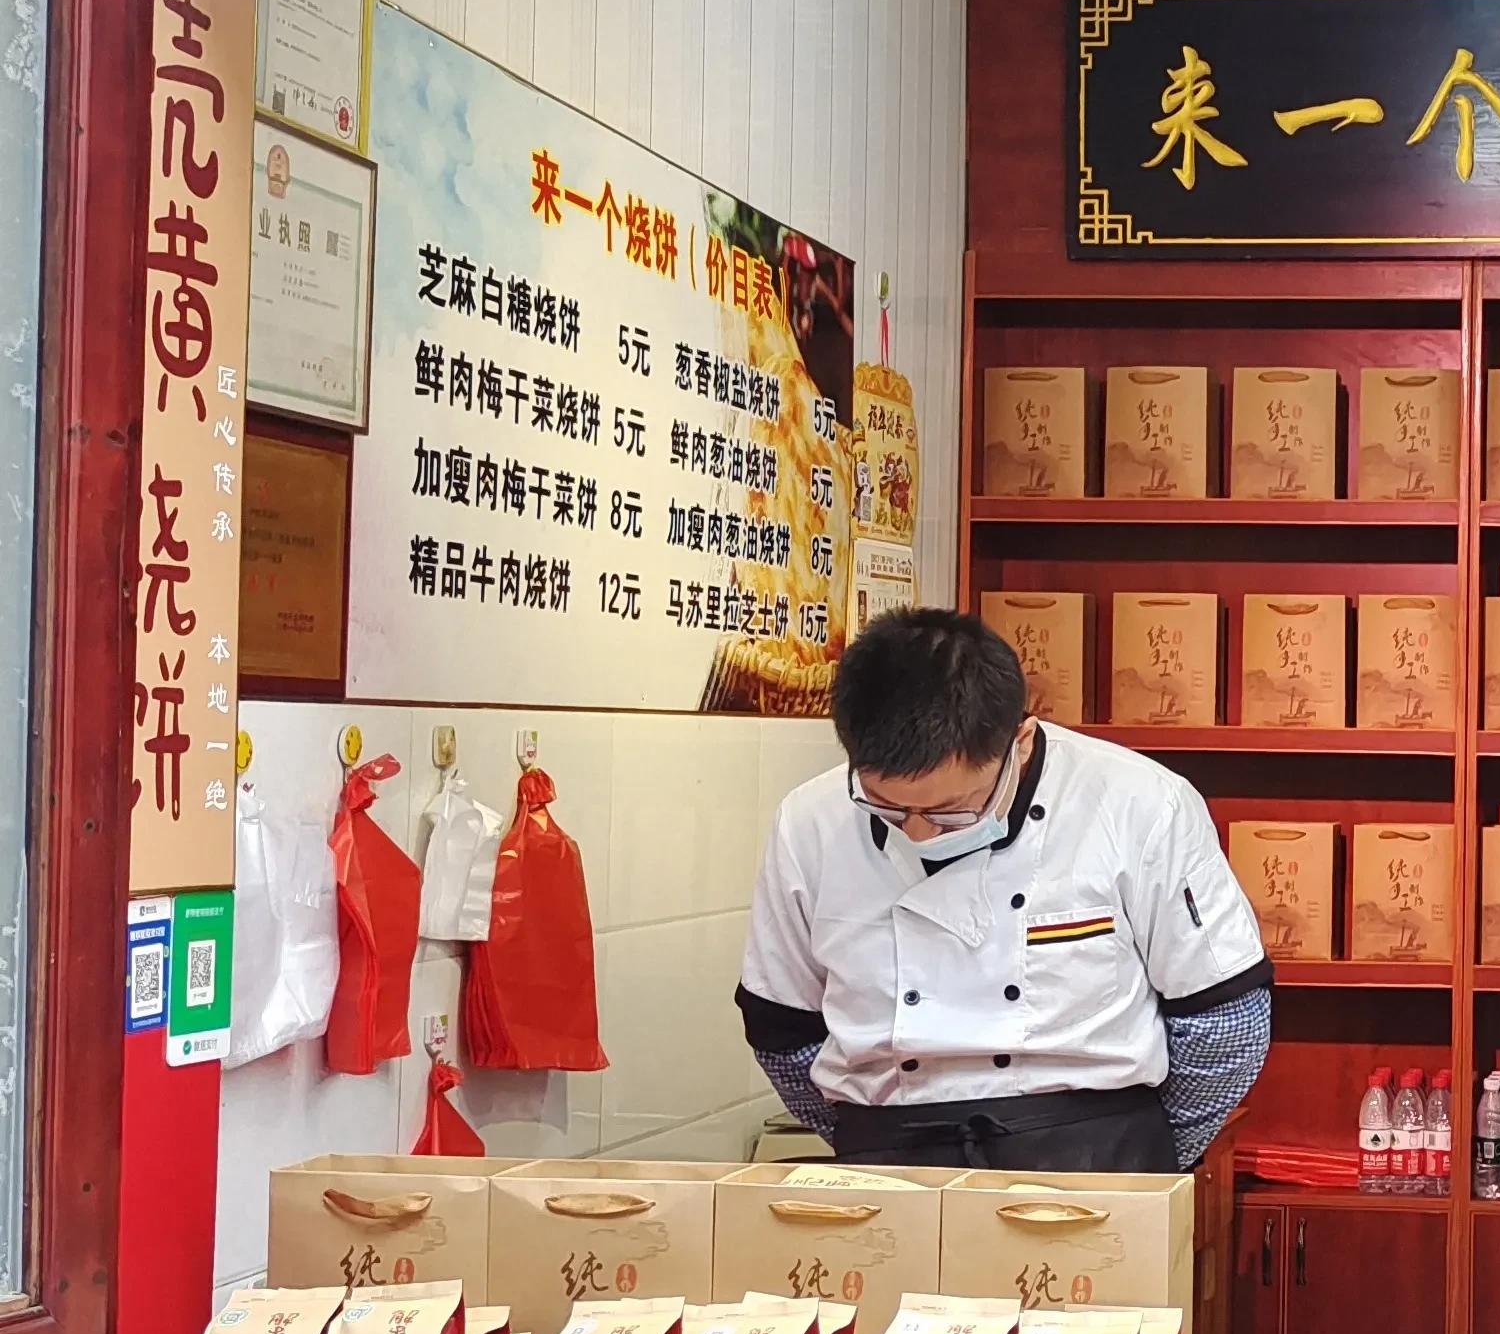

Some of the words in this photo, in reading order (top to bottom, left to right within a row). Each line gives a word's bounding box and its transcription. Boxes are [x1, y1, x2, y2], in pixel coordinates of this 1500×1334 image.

[414, 339, 601, 446] 鲜肉梅干菜烧饼
[613, 406, 646, 457] 5元
[670, 418, 777, 495] 鲜肉葱油烧饼
[811, 467, 833, 508] 5元
[417, 242, 581, 353] 芝麻白糖烧饼
[618, 324, 651, 377] 5元
[674, 341, 780, 422] 葱香椒盐烧饼
[814, 398, 837, 442] 5元
[211, 365, 238, 542] 匠心传承
[411, 436, 598, 531] 加瘦肉梅干菜饼
[610, 490, 643, 539] 8元
[666, 497, 791, 569] 加瘦肉葱油烧饼
[811, 535, 833, 576] 8元
[408, 534, 571, 614] 精品牛肉烧饼
[599, 571, 642, 621] 12元
[665, 578, 790, 641] 马苏里拉芝士饼
[799, 600, 828, 645] 15元
[204, 634, 231, 812] 本地一绝
